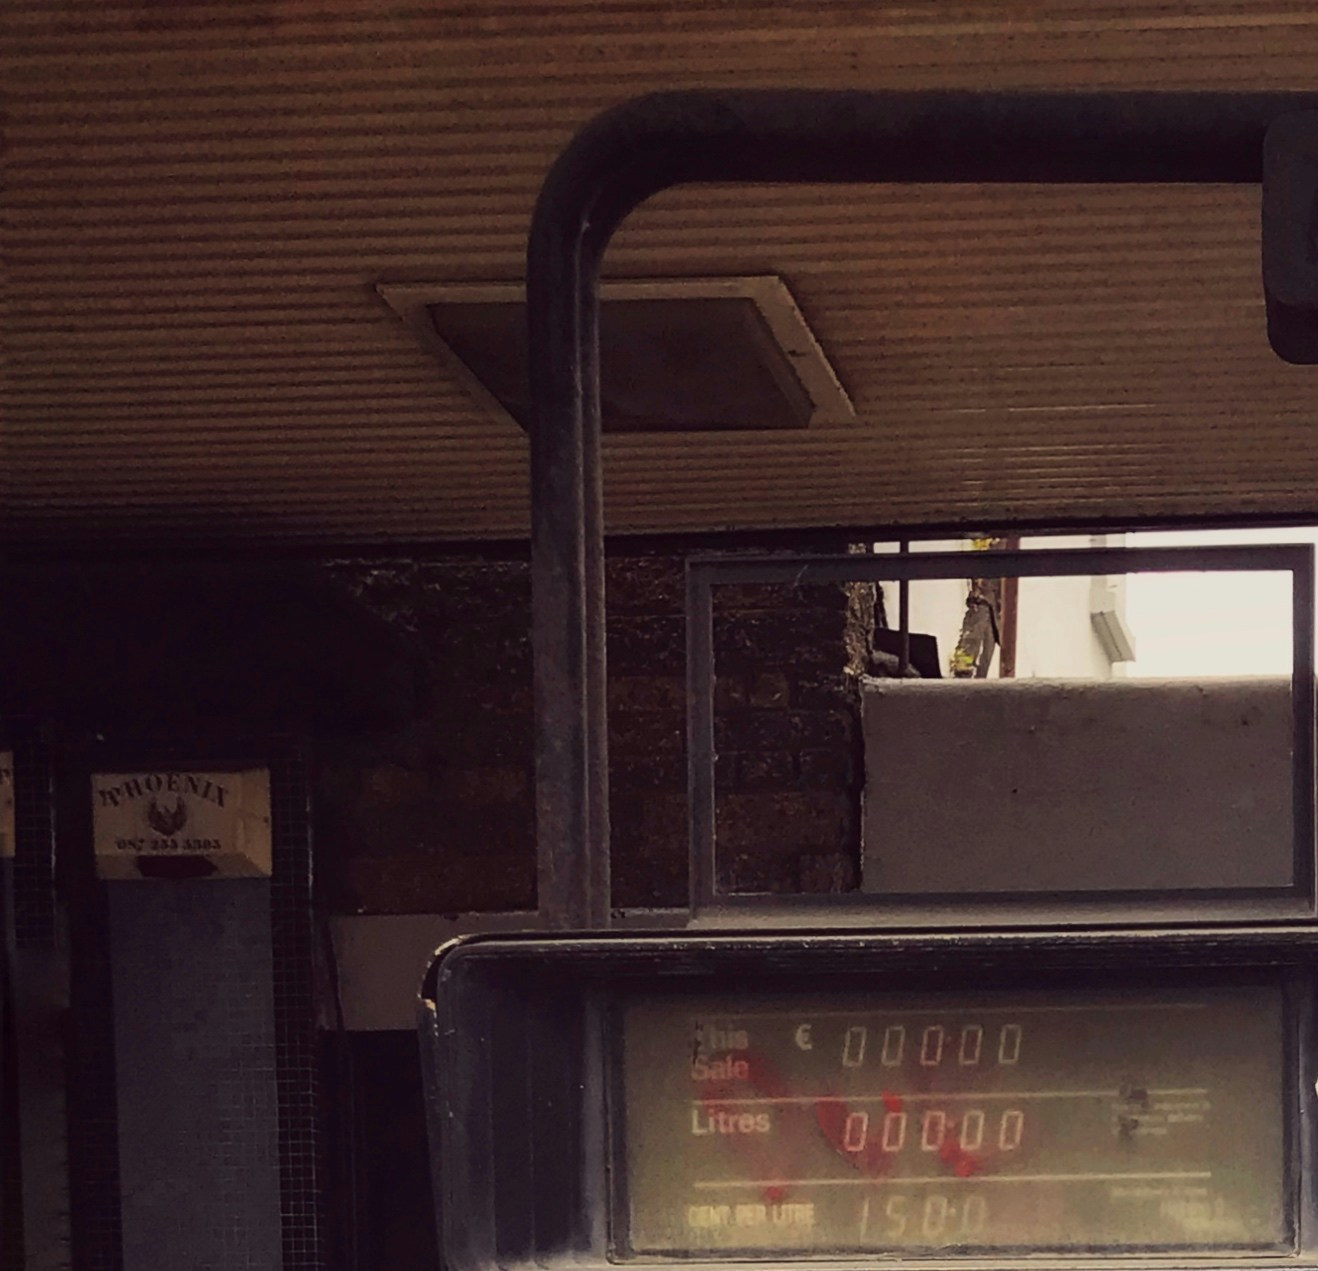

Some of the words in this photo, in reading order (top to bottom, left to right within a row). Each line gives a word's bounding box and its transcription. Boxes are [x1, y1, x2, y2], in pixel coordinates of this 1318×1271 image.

[98, 774, 229, 807] PHOENIX
[795, 1024, 813, 1050] €
[691, 1054, 749, 1081] Sale
[691, 1108, 770, 1136] Litres
